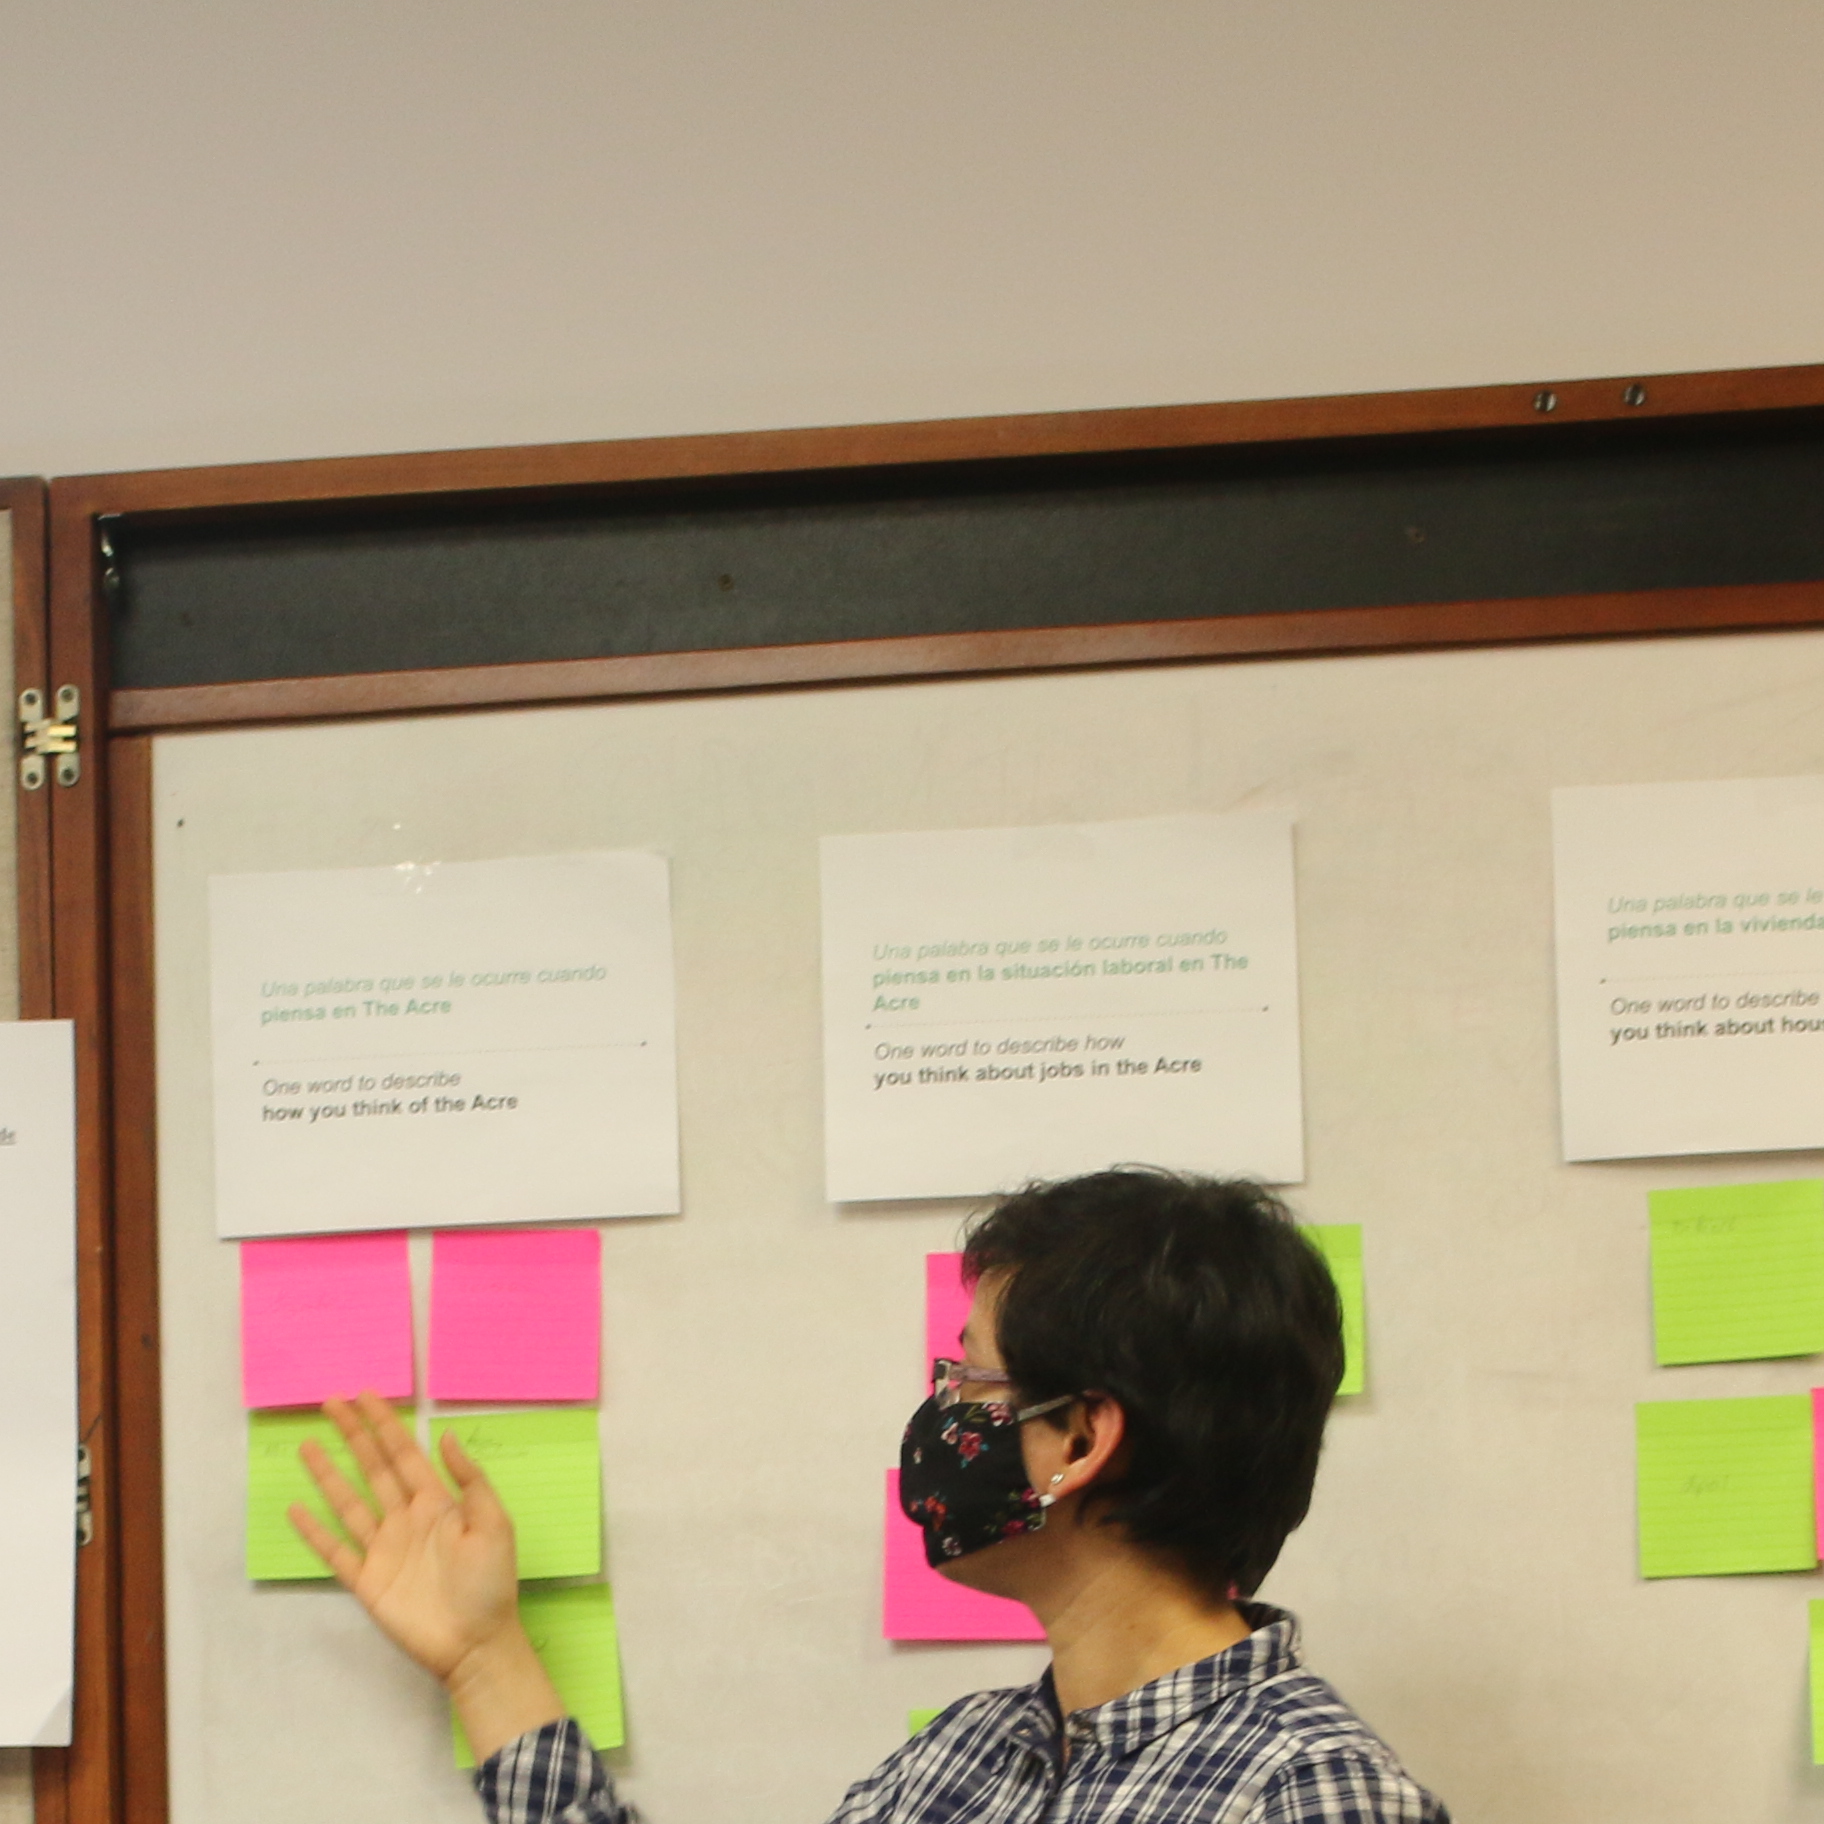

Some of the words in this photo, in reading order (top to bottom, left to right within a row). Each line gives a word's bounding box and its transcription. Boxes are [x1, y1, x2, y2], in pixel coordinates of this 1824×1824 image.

[1606, 895, 1648, 913] Una
[1652, 891, 1727, 914] palabra
[1732, 893, 1770, 910] que
[1776, 891, 1800, 904] se
[1805, 886, 1824, 903] le
[1607, 922, 1677, 940] piensa
[1682, 921, 1709, 934] en
[1714, 916, 1734, 933] la
[872, 943, 912, 960] Una
[916, 939, 989, 962] palabra
[994, 941, 1031, 958] que
[1037, 939, 1060, 952] se
[1064, 934, 1083, 951] le
[1087, 935, 1150, 950] ocurre
[1154, 927, 1228, 947] cuando
[261, 980, 300, 997] Una
[302, 976, 374, 999] palabra
[379, 977, 415, 995] que
[421, 976, 444, 989] se
[447, 972, 466, 988] le
[469, 971, 532, 987] ocurre
[536, 964, 611, 983] cuando
[872, 970, 940, 988] piensa
[945, 968, 972, 982] en
[976, 963, 996, 980] la
[1100, 956, 1174, 975] laboral
[1177, 958, 1204, 972] en
[1211, 953, 1248, 970] The
[260, 1006, 326, 1025] piensa
[331, 1005, 357, 1018] en
[362, 999, 401, 1016] The
[403, 997, 452, 1014] Acre
[871, 991, 920, 1010] Acre
[1609, 997, 1651, 1015] One
[1656, 994, 1706, 1012] word
[1710, 993, 1730, 1009] to
[1734, 988, 1820, 1008] describe
[1610, 1026, 1650, 1043] you
[1654, 1020, 1707, 1038] think
[1714, 1017, 1774, 1036] about
[873, 1042, 914, 1059] One
[920, 1039, 968, 1057] word
[971, 1038, 992, 1055] to
[994, 1034, 1078, 1054] describe
[1084, 1031, 1125, 1049] how
[260, 1079, 301, 1096] One
[306, 1076, 353, 1093] word
[357, 1075, 377, 1091] to
[380, 1070, 461, 1089] describe
[874, 1071, 912, 1088] you
[917, 1065, 969, 1083] think
[975, 1062, 1035, 1080] about
[1039, 1060, 1084, 1081] jobs
[1090, 1063, 1110, 1076] in
[1115, 1057, 1148, 1075] the
[1154, 1055, 1202, 1073] Acre
[261, 1103, 304, 1120] how
[309, 1104, 347, 1121] you
[351, 1098, 402, 1115] think
[407, 1096, 429, 1112] of
[433, 1094, 466, 1111] the
[470, 1092, 518, 1109] Acre
